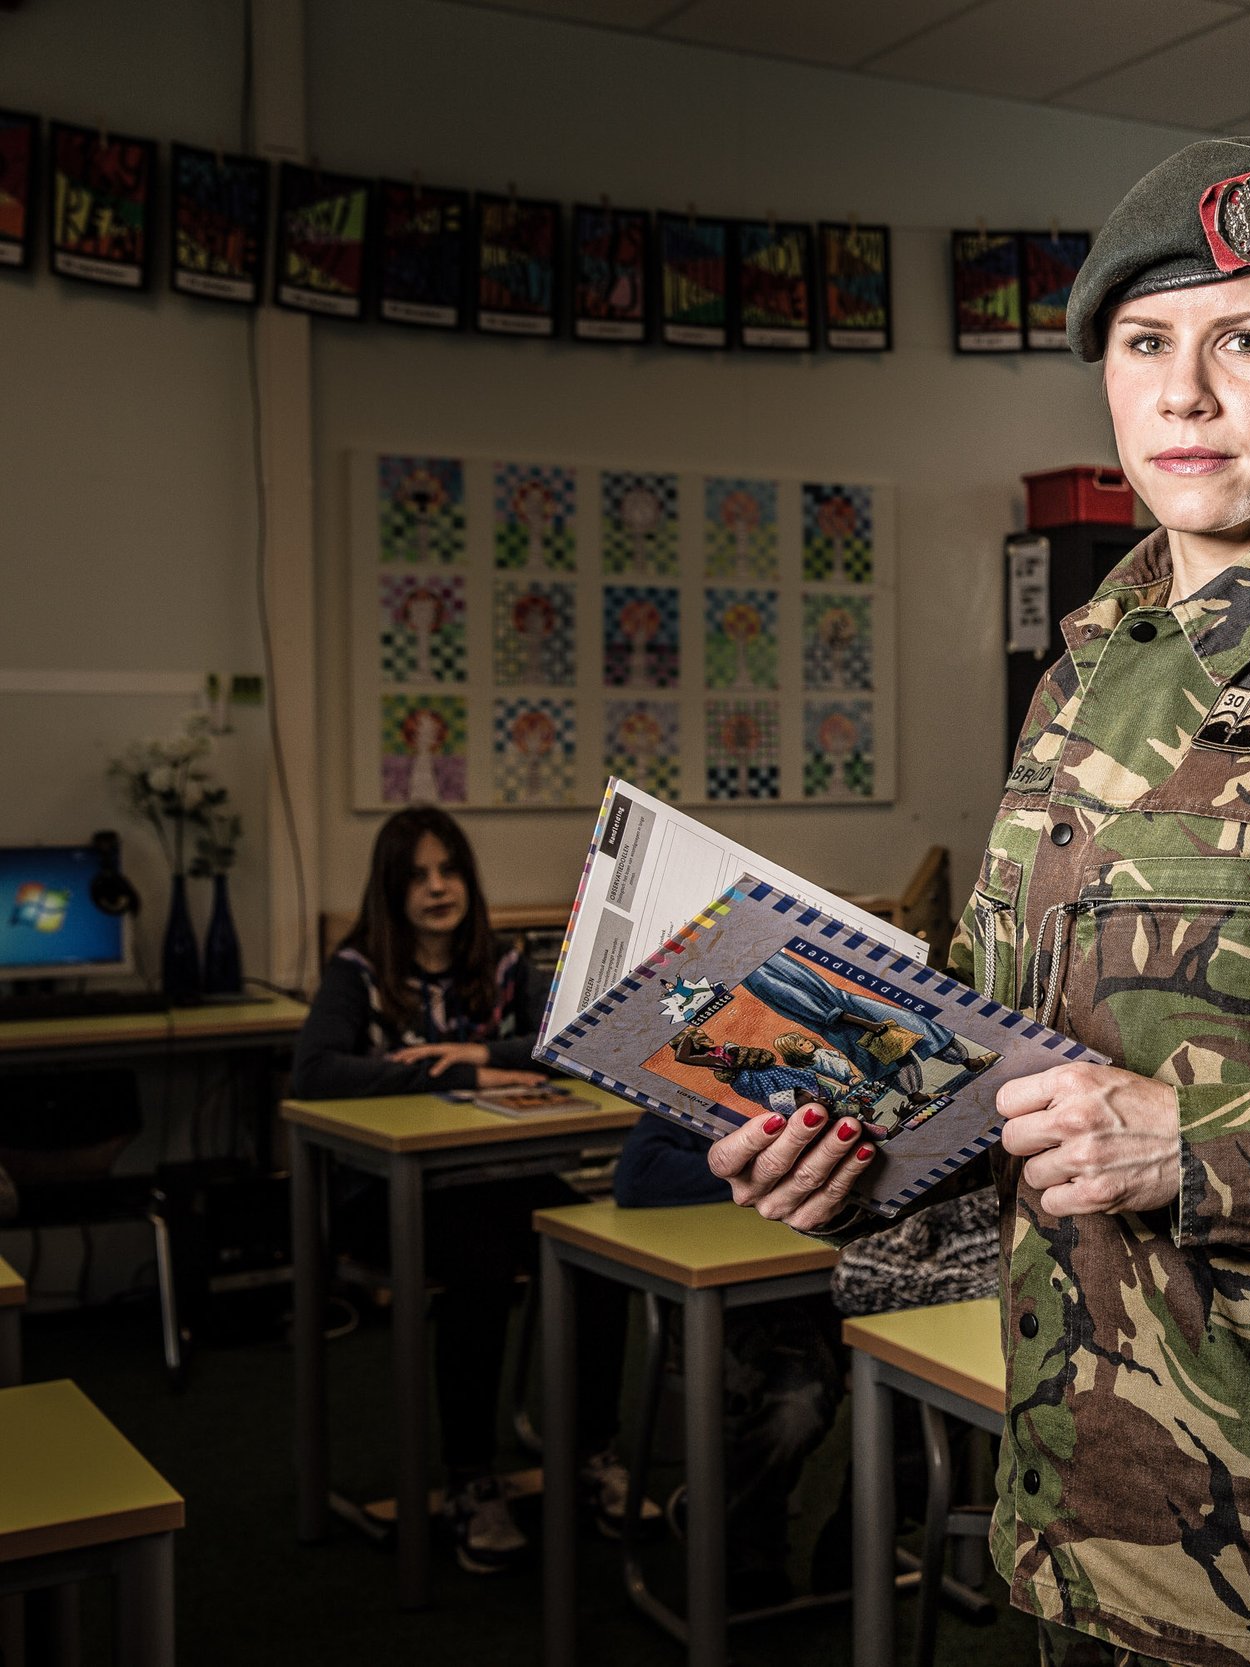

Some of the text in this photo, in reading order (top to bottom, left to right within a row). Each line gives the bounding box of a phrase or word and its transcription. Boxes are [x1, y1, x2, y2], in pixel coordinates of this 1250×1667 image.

[1224, 693, 1245, 708] 30
[608, 806, 625, 845] Handleiding
[610, 844, 630, 901] OBSERVATIEDOELEN
[795, 942, 925, 1011] Handleiding
[691, 994, 732, 1026] Estafette
[676, 1089, 710, 1107] Zwijsen
